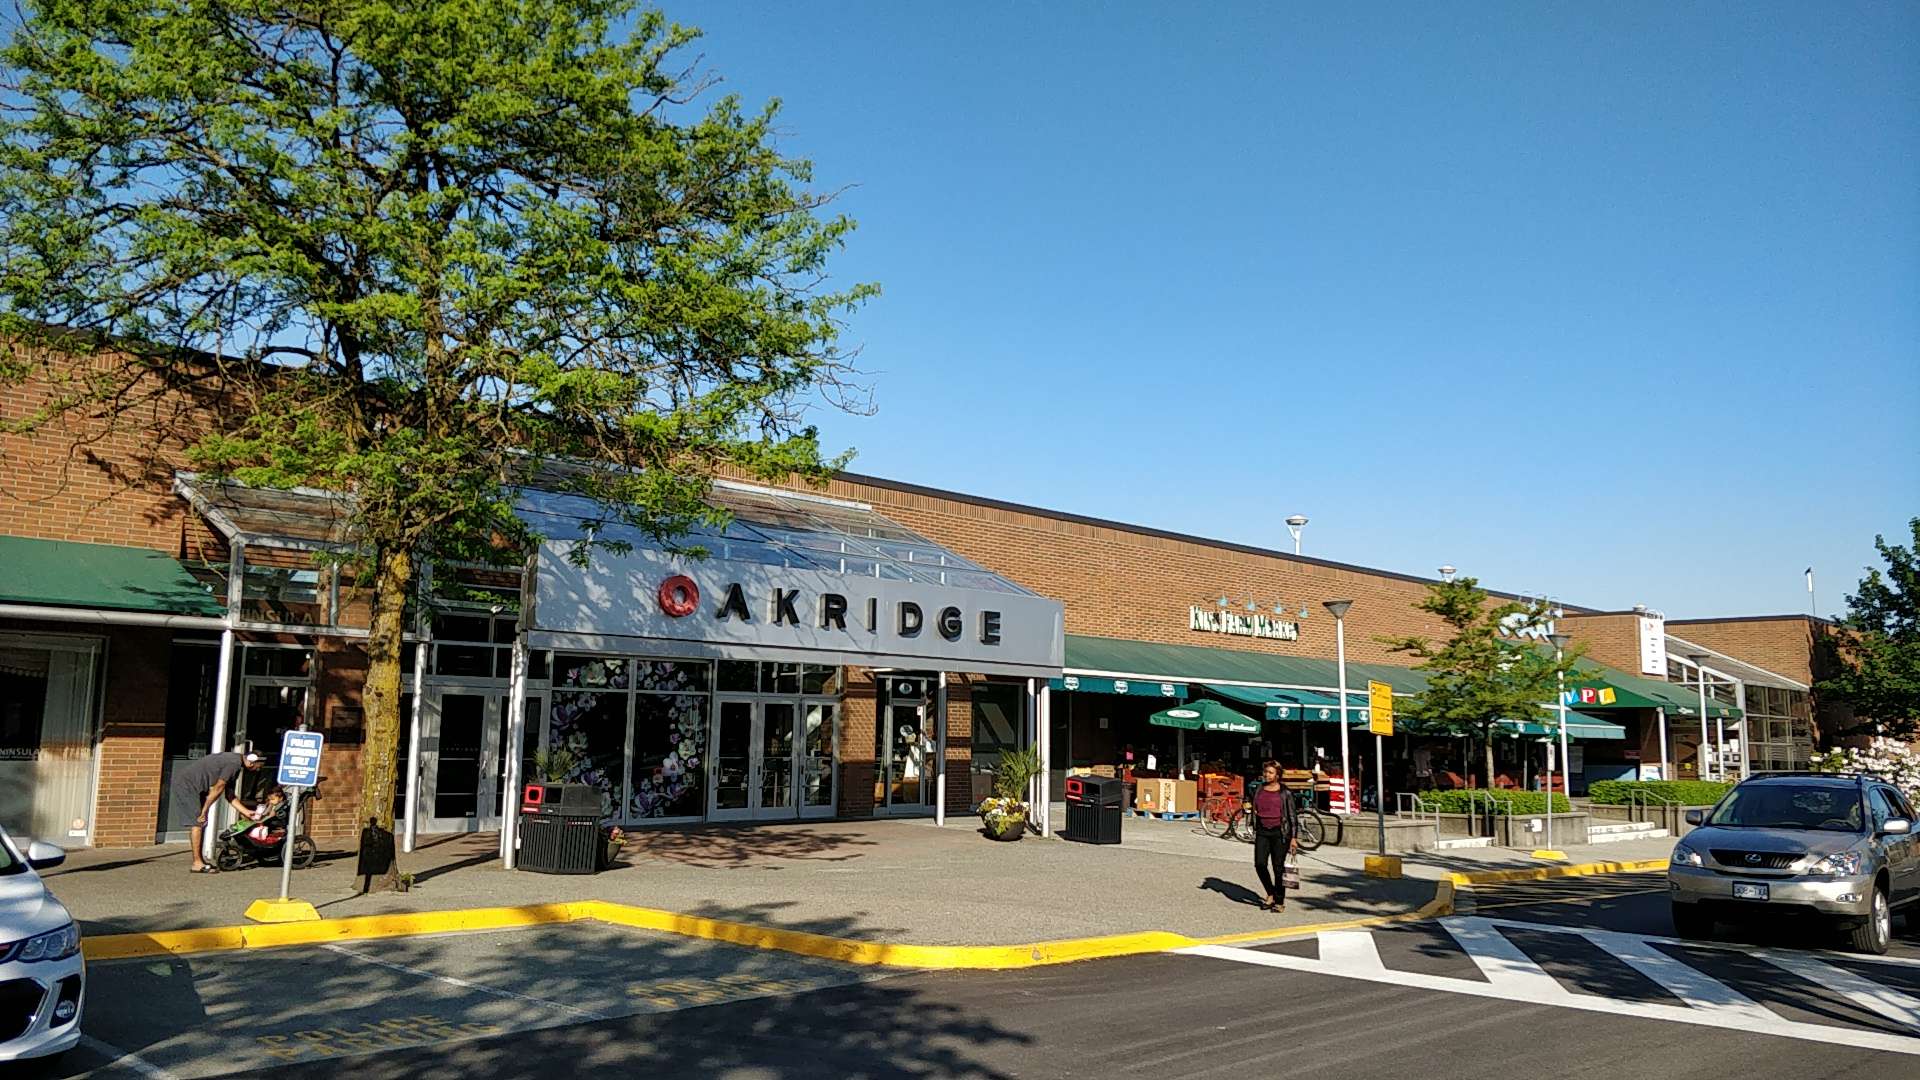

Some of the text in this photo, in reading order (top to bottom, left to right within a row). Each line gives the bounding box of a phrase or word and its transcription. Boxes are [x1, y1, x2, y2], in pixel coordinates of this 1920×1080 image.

[659, 575, 1001, 645] OAKRIDGE
[1564, 688, 1616, 705] VPL
[256, 1014, 452, 1045] POLICE
